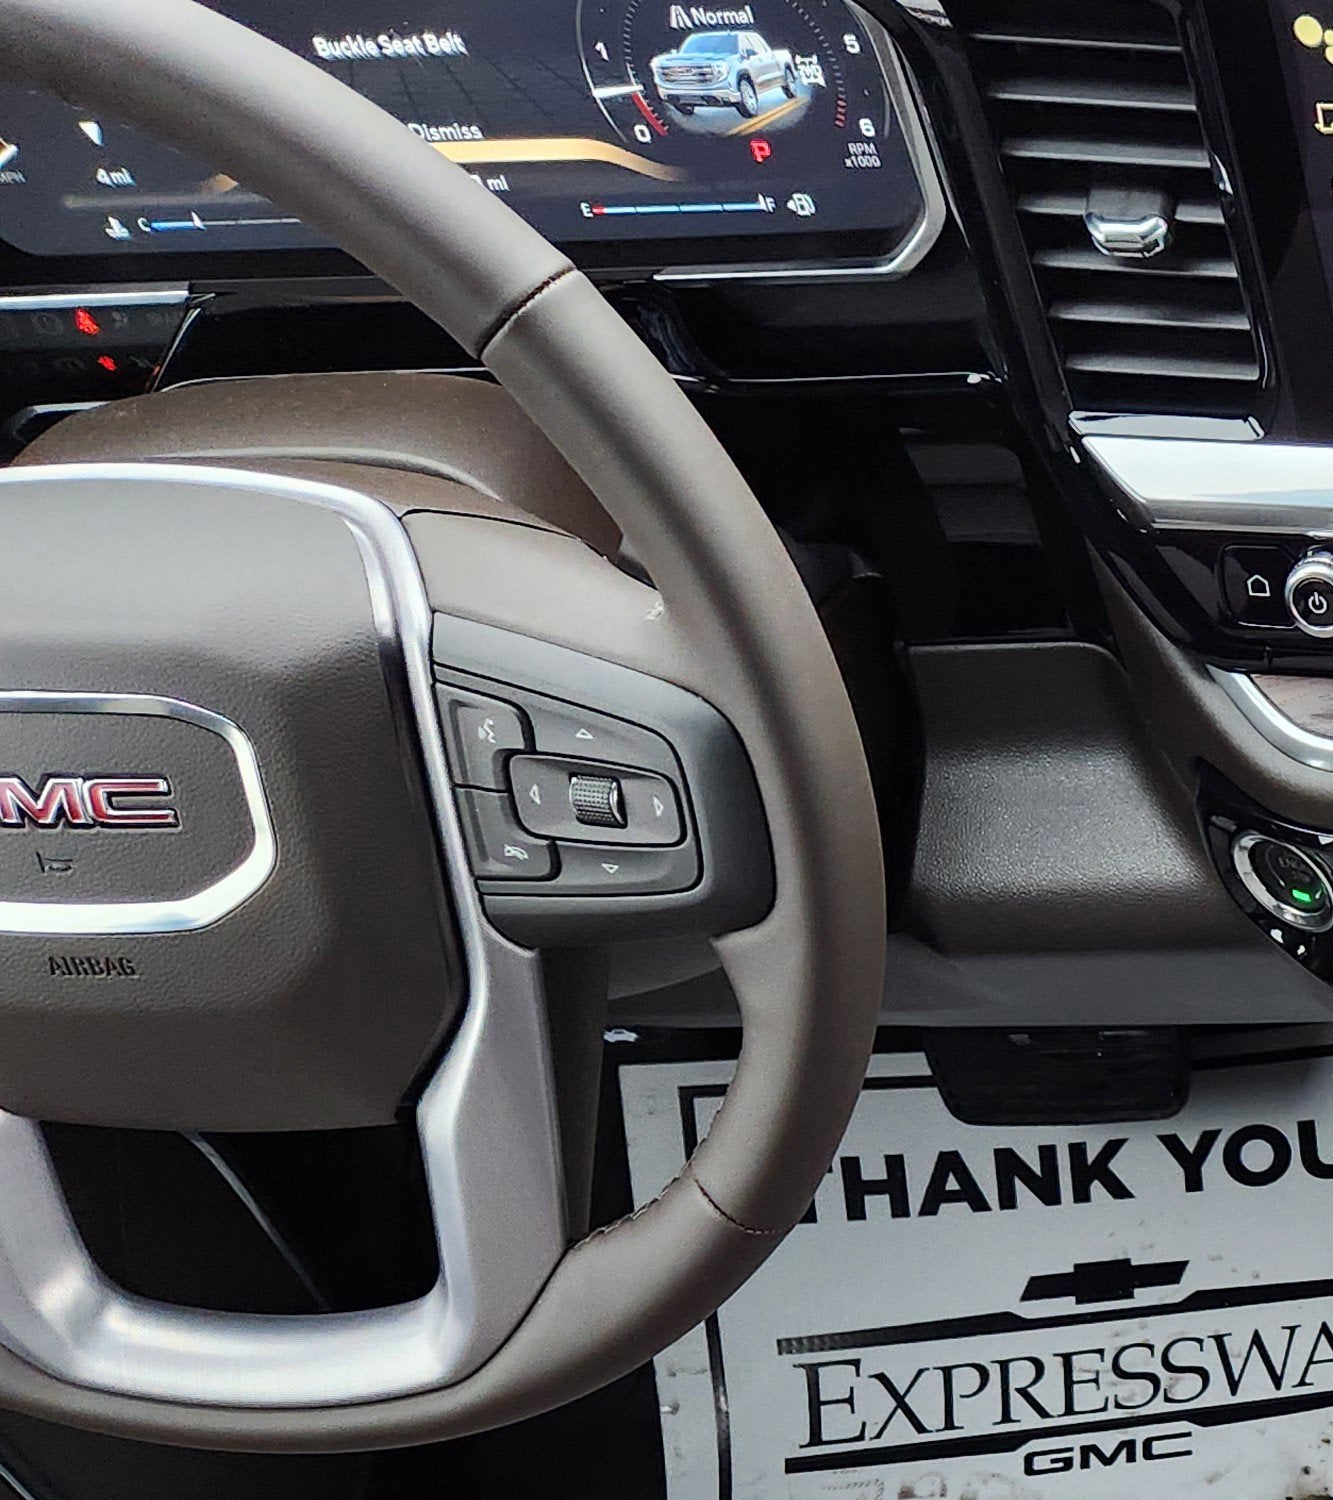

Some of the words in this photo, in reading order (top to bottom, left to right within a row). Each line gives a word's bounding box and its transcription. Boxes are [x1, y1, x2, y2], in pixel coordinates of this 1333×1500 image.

[690, 5, 755, 27] Normal
[312, 34, 383, 60] Buckle
[377, 33, 427, 58] Seat
[421, 31, 470, 56] Belt
[594, 41, 609, 62] 1
[843, 33, 861, 55] 5
[407, 122, 485, 141] Dismiss
[634, 124, 652, 144] 0
[858, 117, 876, 138] 6
[750, 138, 771, 163] P
[848, 142, 879, 156] RPM
[844, 155, 881, 169] x1000
[580, 202, 594, 219] E
[48, 955, 138, 978] AIRBAG
[799, 1136, 1136, 1224] HANK
[1022, 1429, 1193, 1477] GMC
